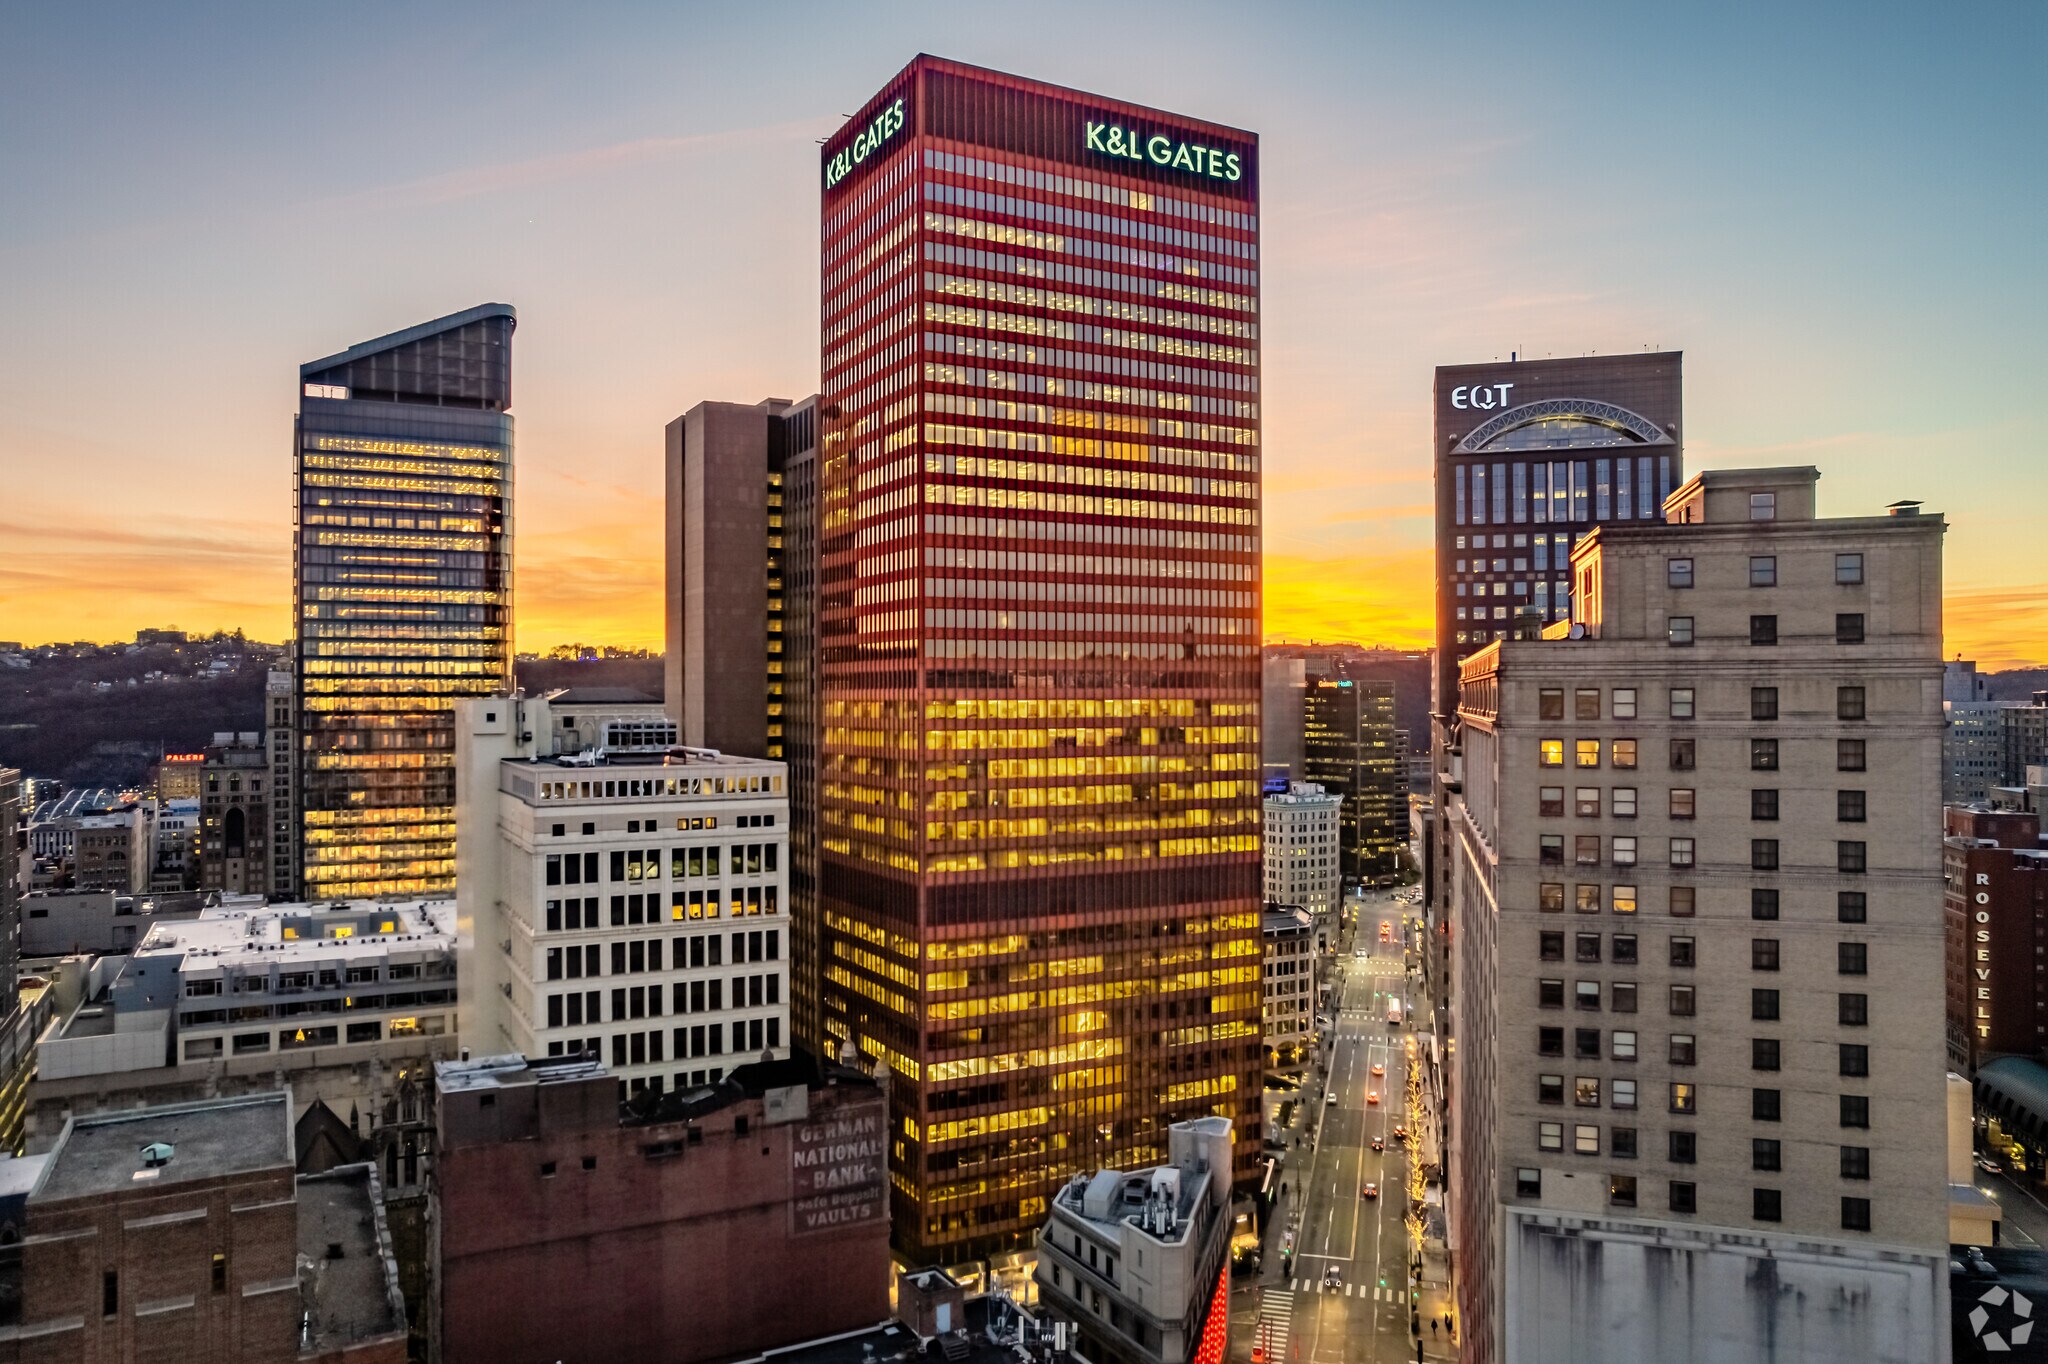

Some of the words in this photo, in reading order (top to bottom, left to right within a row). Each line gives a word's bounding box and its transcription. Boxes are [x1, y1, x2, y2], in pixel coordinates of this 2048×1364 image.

[826, 146, 852, 190] K&L
[853, 98, 904, 164] GATES
[1087, 121, 1143, 160] K&L
[1147, 135, 1241, 181] GATES
[1451, 383, 1514, 410] EQT
[1975, 873, 1990, 1038] ROOSEVELT
[801, 1116, 875, 1142] GERMAN
[794, 1140, 881, 1168] NATIONAL
[814, 1163, 866, 1189] BANK
[806, 1203, 871, 1227] VAULTS
